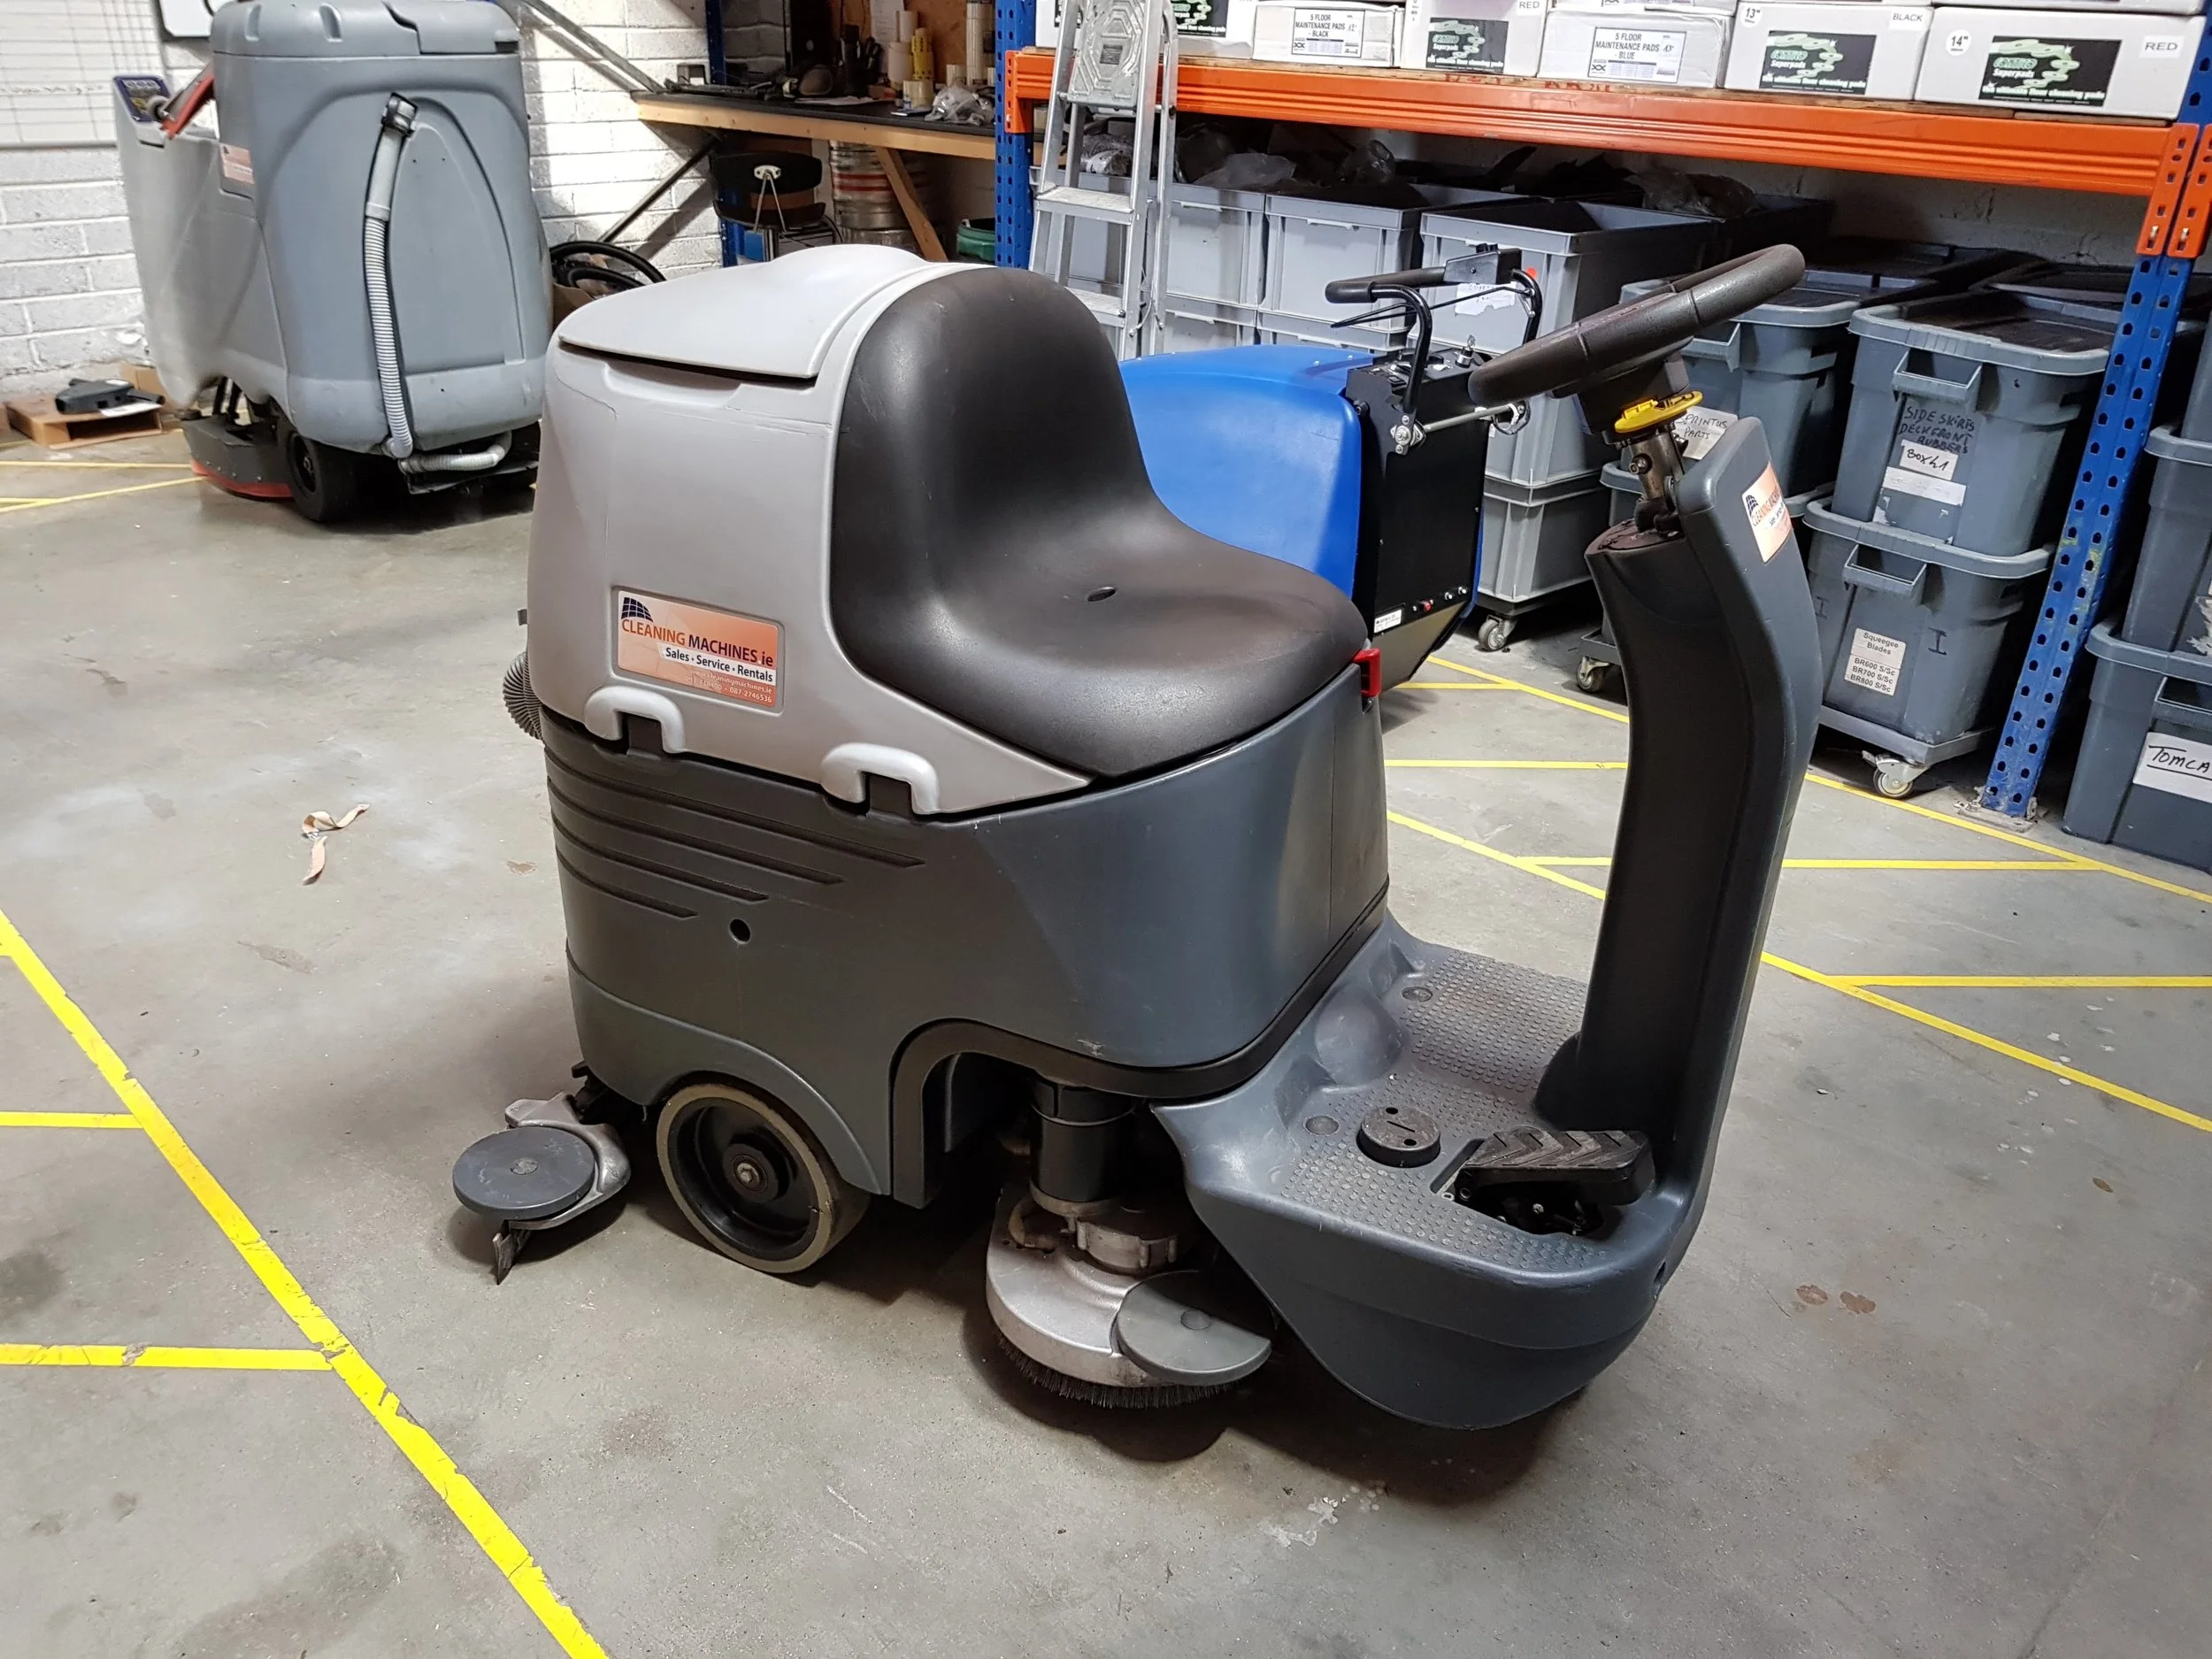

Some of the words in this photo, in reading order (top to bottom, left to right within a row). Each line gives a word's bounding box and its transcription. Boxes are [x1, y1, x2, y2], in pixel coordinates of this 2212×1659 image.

[1746, 8, 1761, 19] 13"
[1893, 13, 1923, 22] BLACK
[1595, 41, 1640, 50] MAINTENANCE
[1642, 43, 1660, 52] PADS
[1951, 35, 1968, 47] 14"
[2145, 42, 2178, 51] RED
[1993, 68, 2035, 79] Superpads
[1904, 406, 1937, 423] SIDE
[1684, 426, 1710, 440] PARTS
[1899, 423, 1930, 435] DECK
[1931, 427, 1973, 446] FRONT
[1917, 435, 1968, 454] RUBBERS
[621, 618, 686, 646] CLEANING
[1863, 632, 1899, 649] Squeegee
[1867, 641, 1892, 655] Blades
[665, 647, 689, 662] Sales
[696, 655, 730, 672] Service
[737, 664, 773, 682] Rentals
[1855, 657, 1878, 670] BR600
[1879, 665, 1895, 676] S/Sc
[1852, 665, 1876, 678] BR700
[1877, 674, 1893, 685] S/Sc
[1874, 682, 1891, 693] S/Sc
